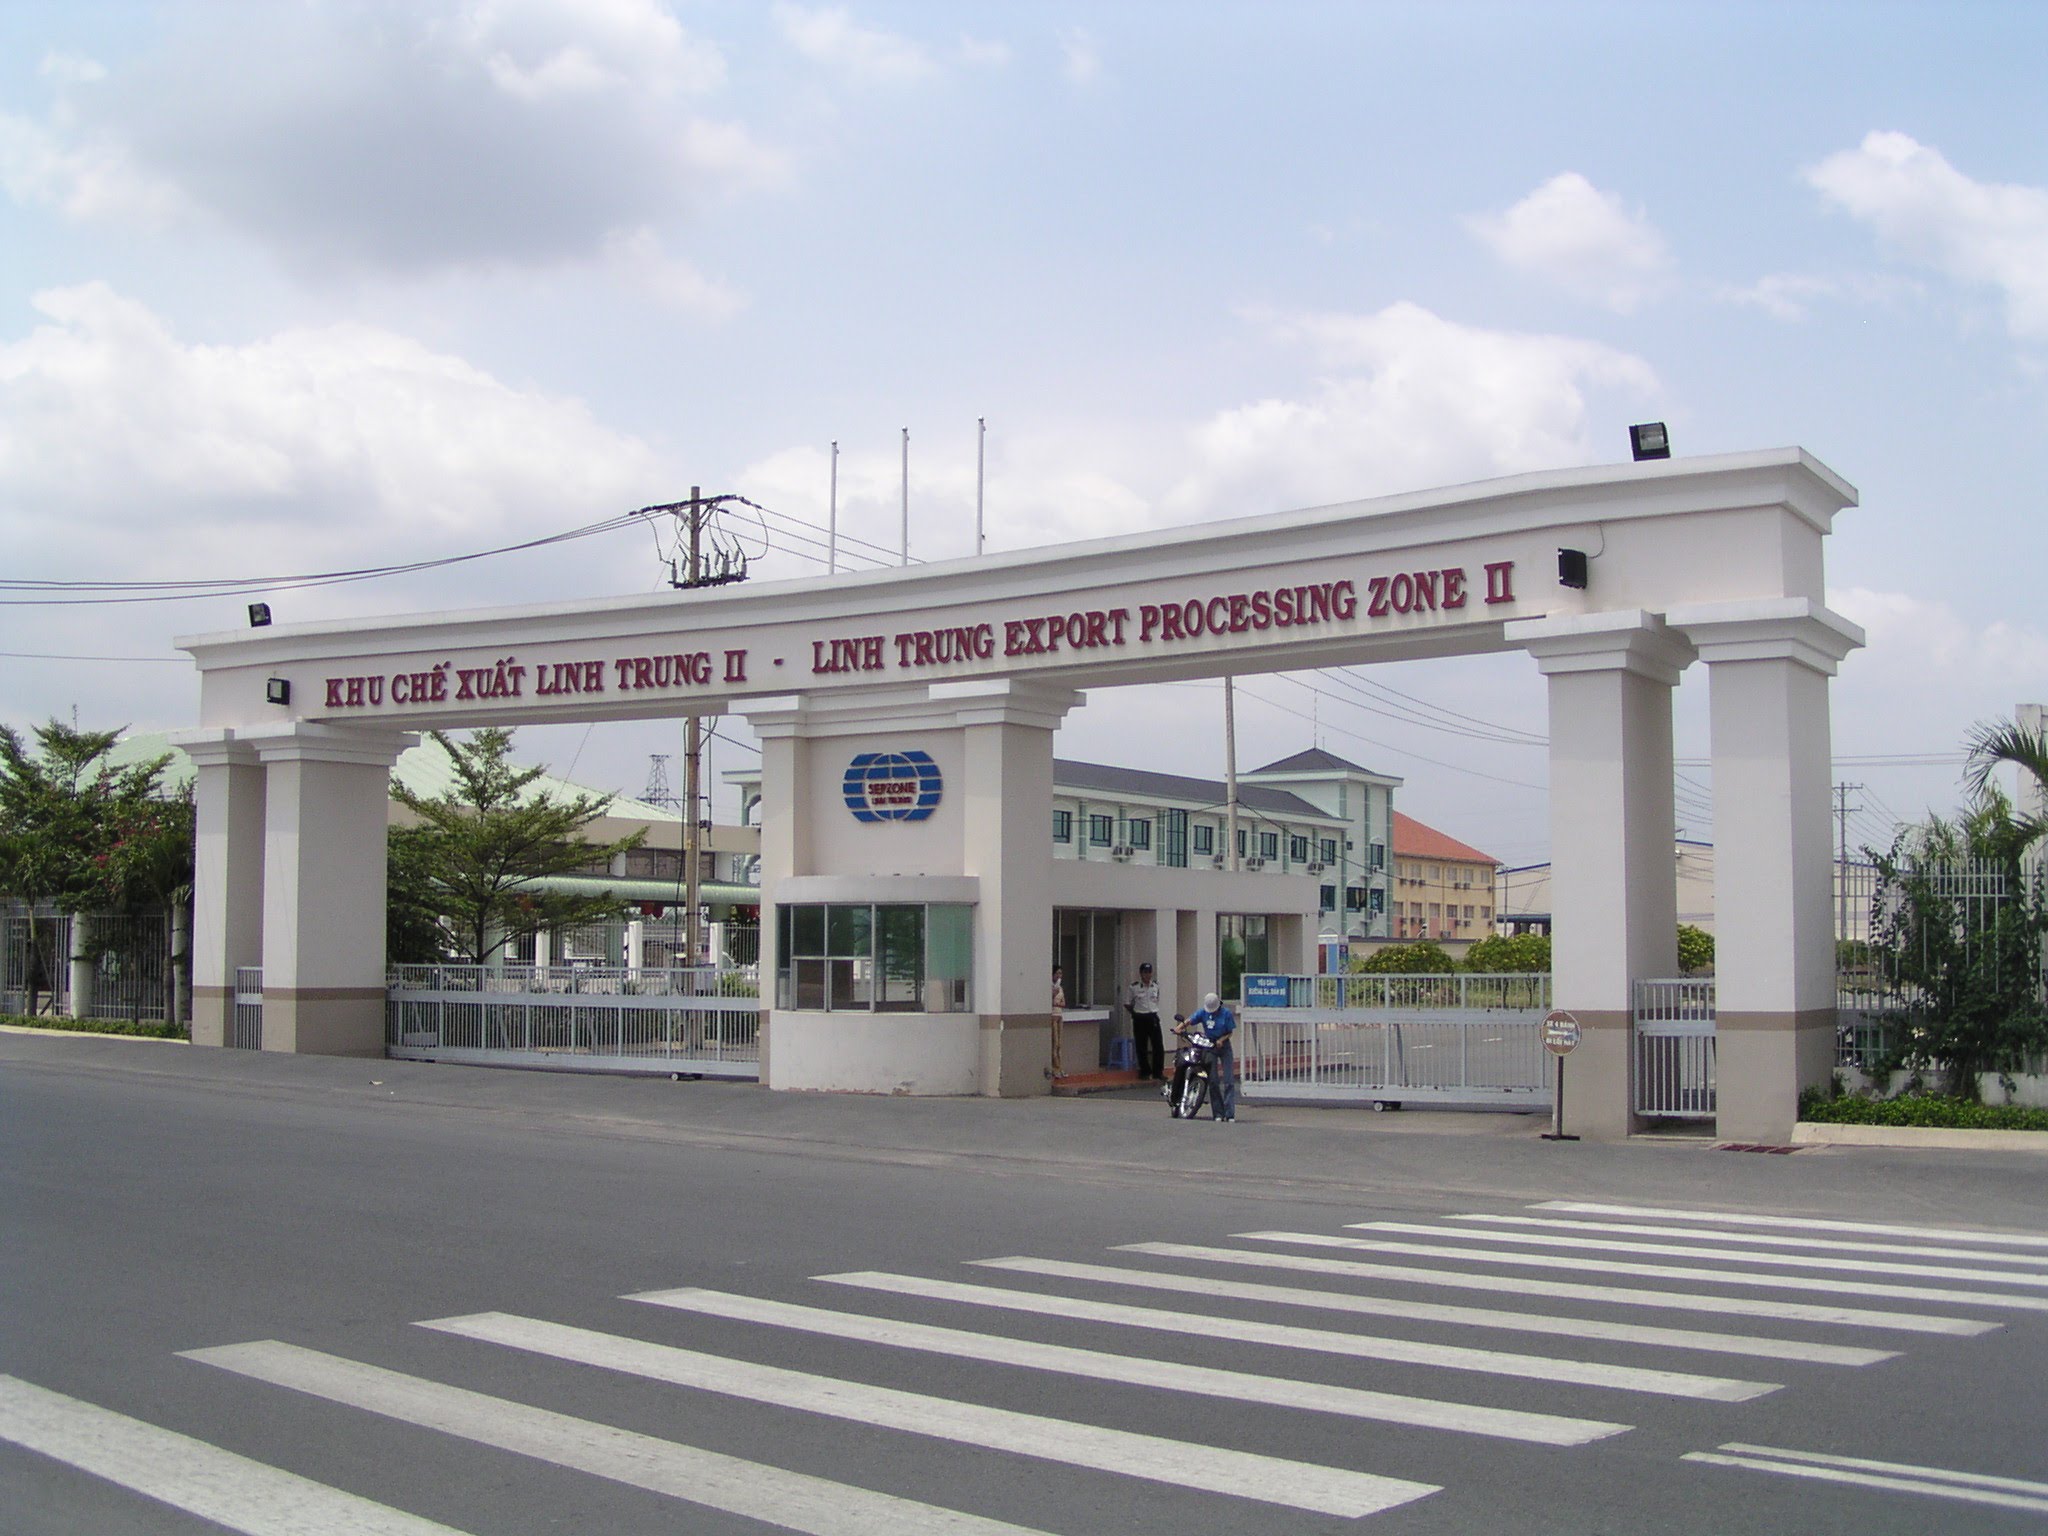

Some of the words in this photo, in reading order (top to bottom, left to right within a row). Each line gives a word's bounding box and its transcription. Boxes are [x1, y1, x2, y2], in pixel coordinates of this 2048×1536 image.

[325, 676, 385, 707] KHU
[391, 661, 451, 702] CHẾ
[456, 656, 526, 699] XUẤT
[536, 660, 605, 694] LINH
[615, 652, 712, 689] TRUNG
[723, 649, 748, 682] II
[812, 636, 885, 673] LINH
[894, 623, 996, 667] TRUNG
[1004, 608, 1129, 656] EXPORT
[1139, 580, 1357, 642] PROCESSING
[1367, 568, 1466, 617] ZONE
[1483, 561, 1515, 604] II
[868, 782, 917, 795] SEPZONE
